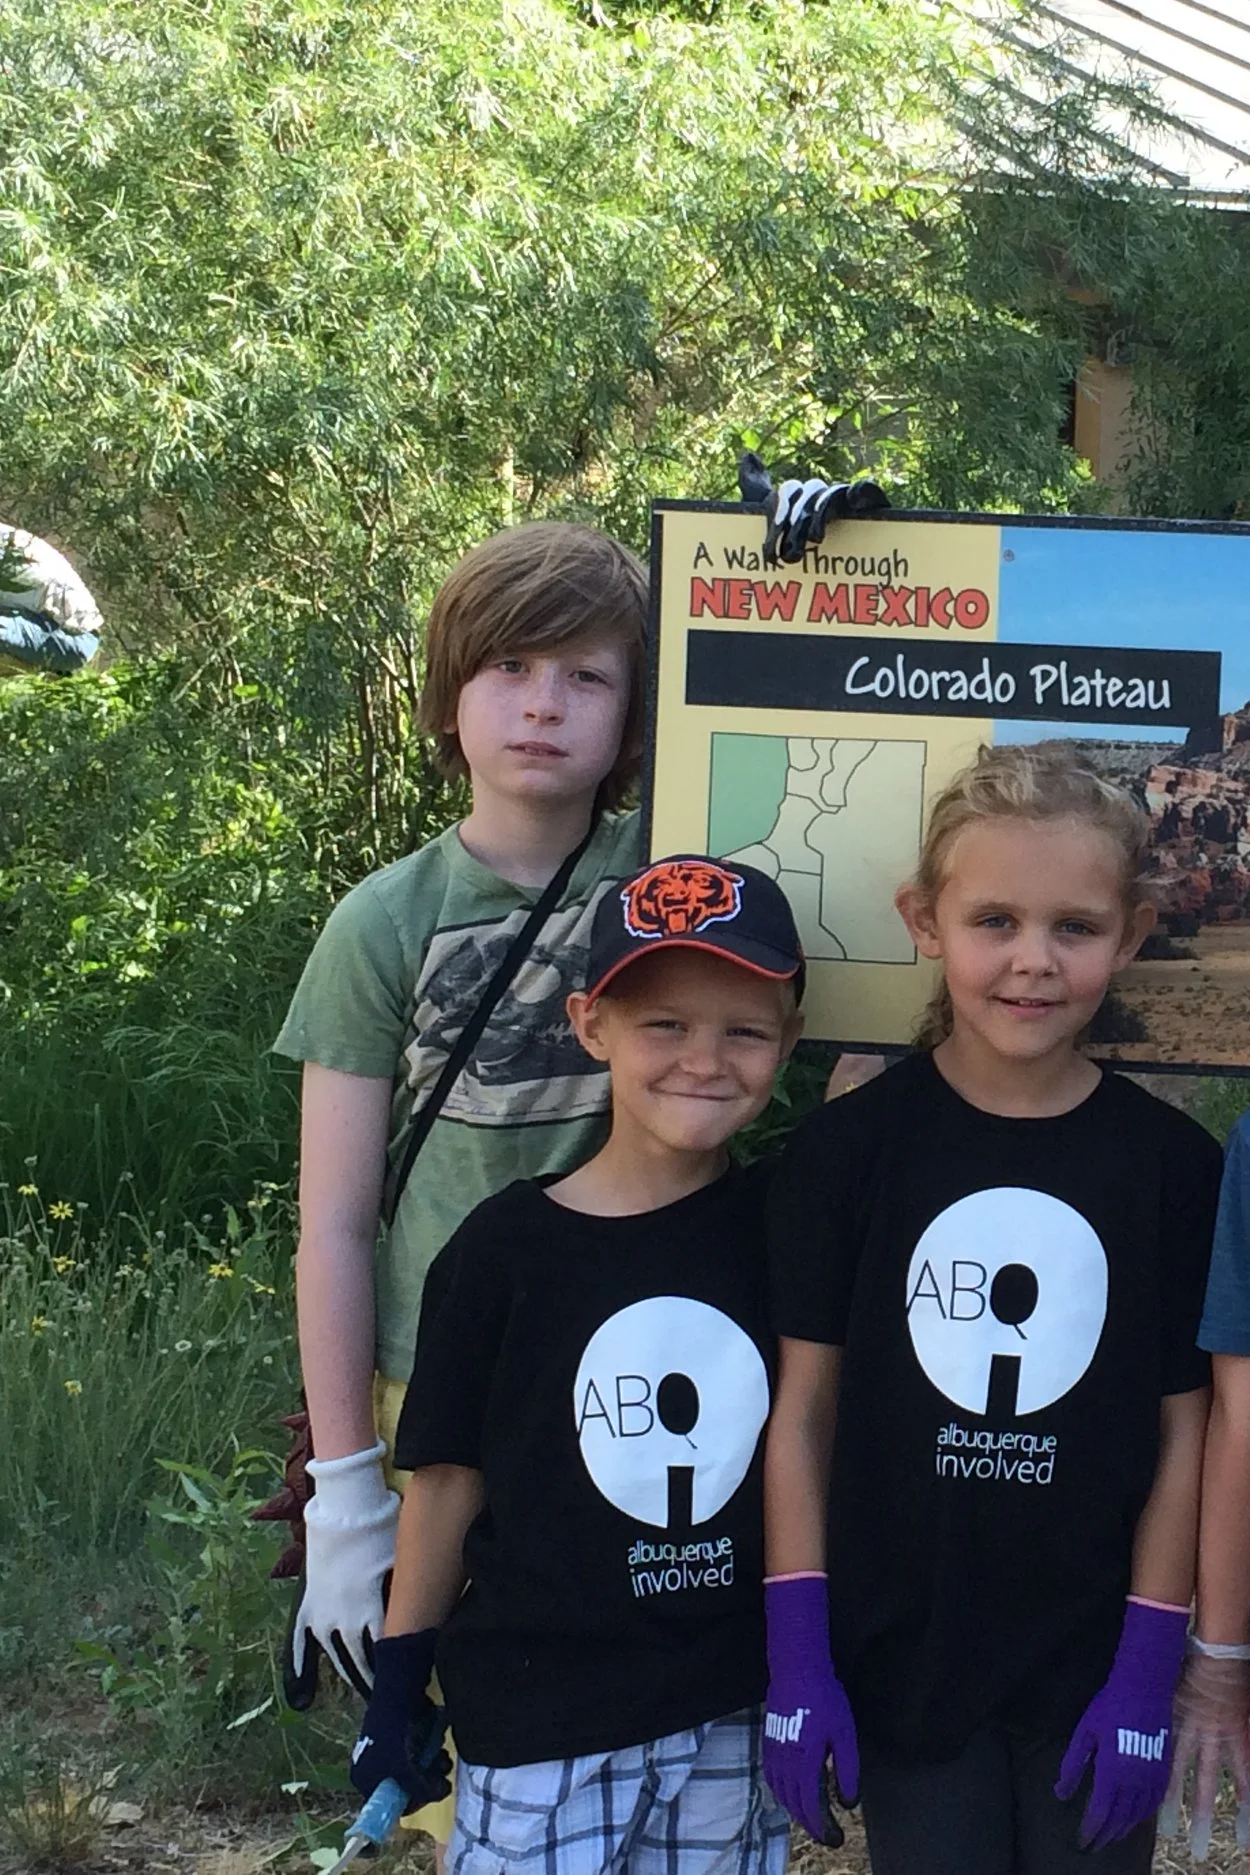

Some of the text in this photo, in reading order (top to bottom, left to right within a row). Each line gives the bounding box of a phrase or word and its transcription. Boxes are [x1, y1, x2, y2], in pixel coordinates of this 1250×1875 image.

[693, 541, 714, 569] A
[802, 546, 909, 589] Through
[689, 576, 990, 630] NEW MEXICO
[845, 653, 1171, 709] Colorado Plateau
[905, 1258, 1040, 1341] ABQ
[577, 1371, 700, 1450] ABQ
[936, 1422, 1058, 1457] albuquerque
[935, 1446, 1055, 1485] involved
[627, 1536, 734, 1567] albuquerque
[629, 1554, 735, 1599] involved
[765, 1708, 804, 1744] mud
[1117, 1728, 1165, 1761] mud
